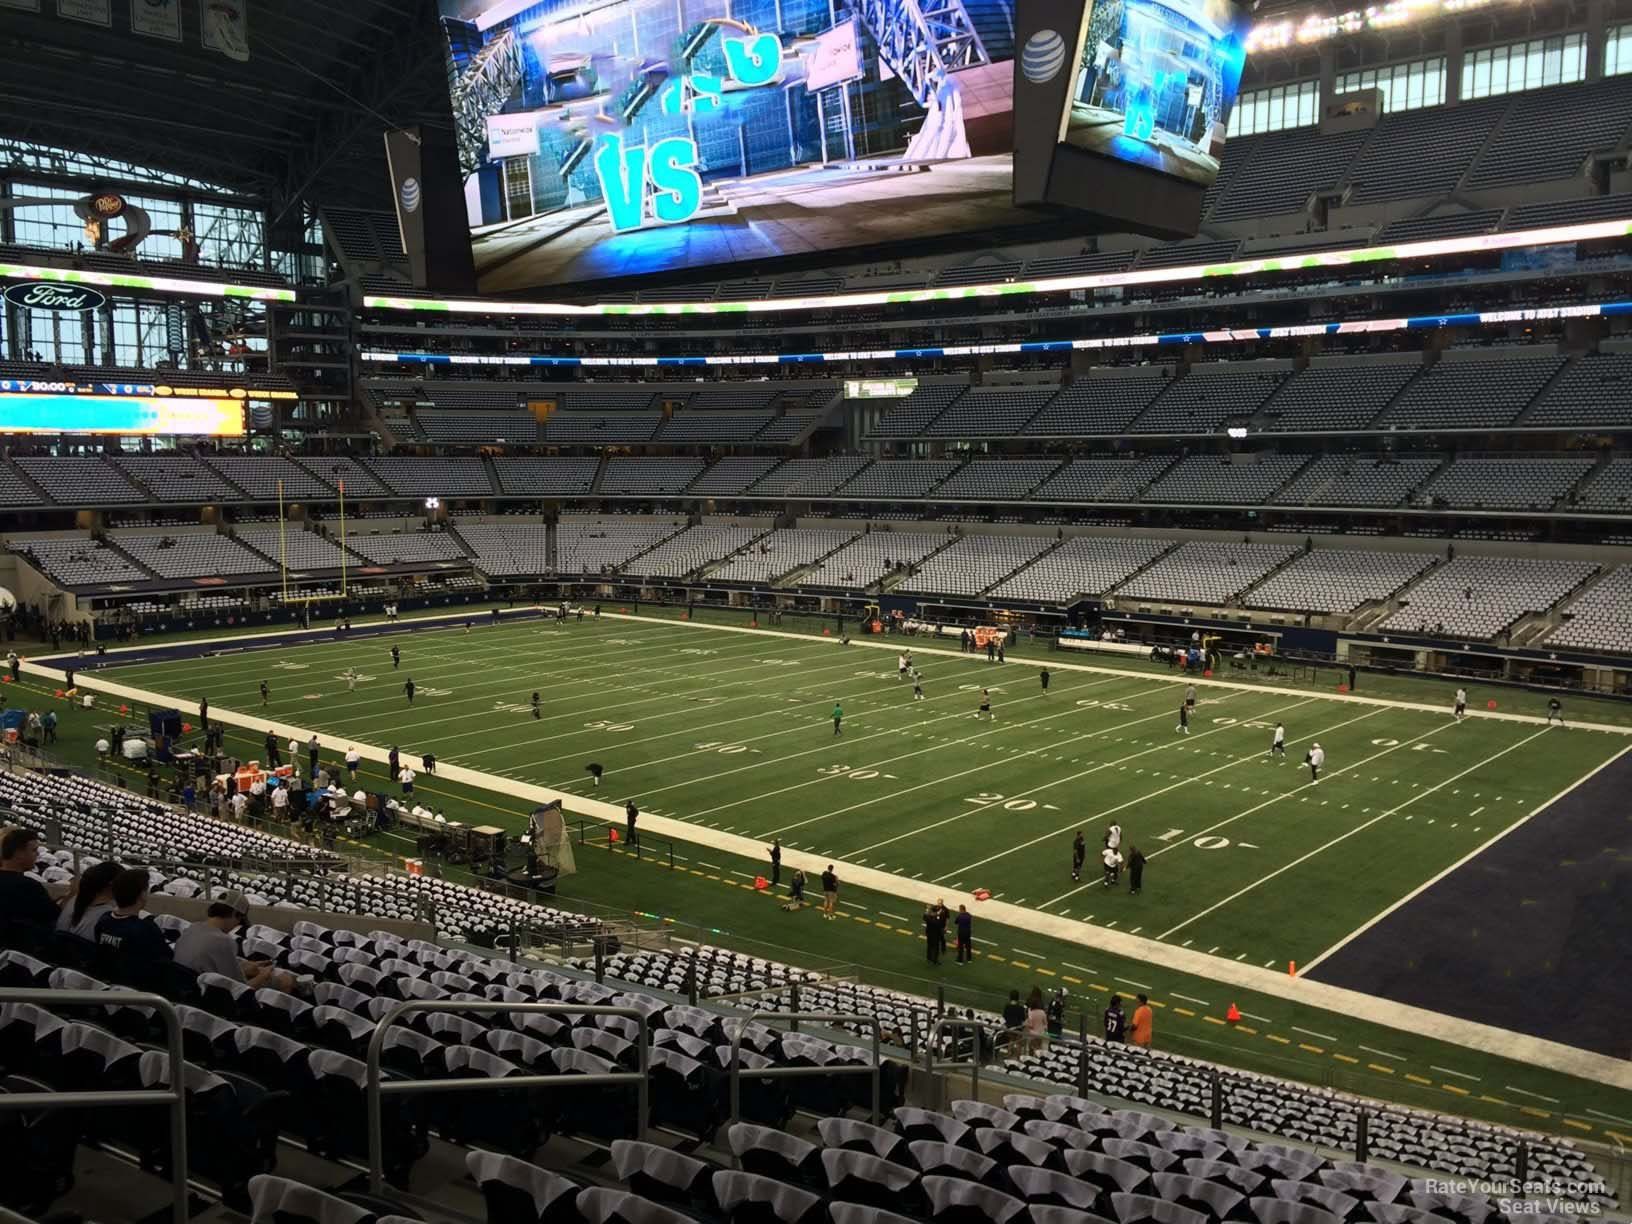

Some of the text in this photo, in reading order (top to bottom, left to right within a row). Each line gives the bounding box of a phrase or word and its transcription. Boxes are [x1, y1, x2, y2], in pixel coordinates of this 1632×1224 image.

[594, 132, 703, 233] VS
[24, 285, 88, 308] Ford
[963, 792, 1038, 811] 20
[1150, 827, 1231, 850] 10
